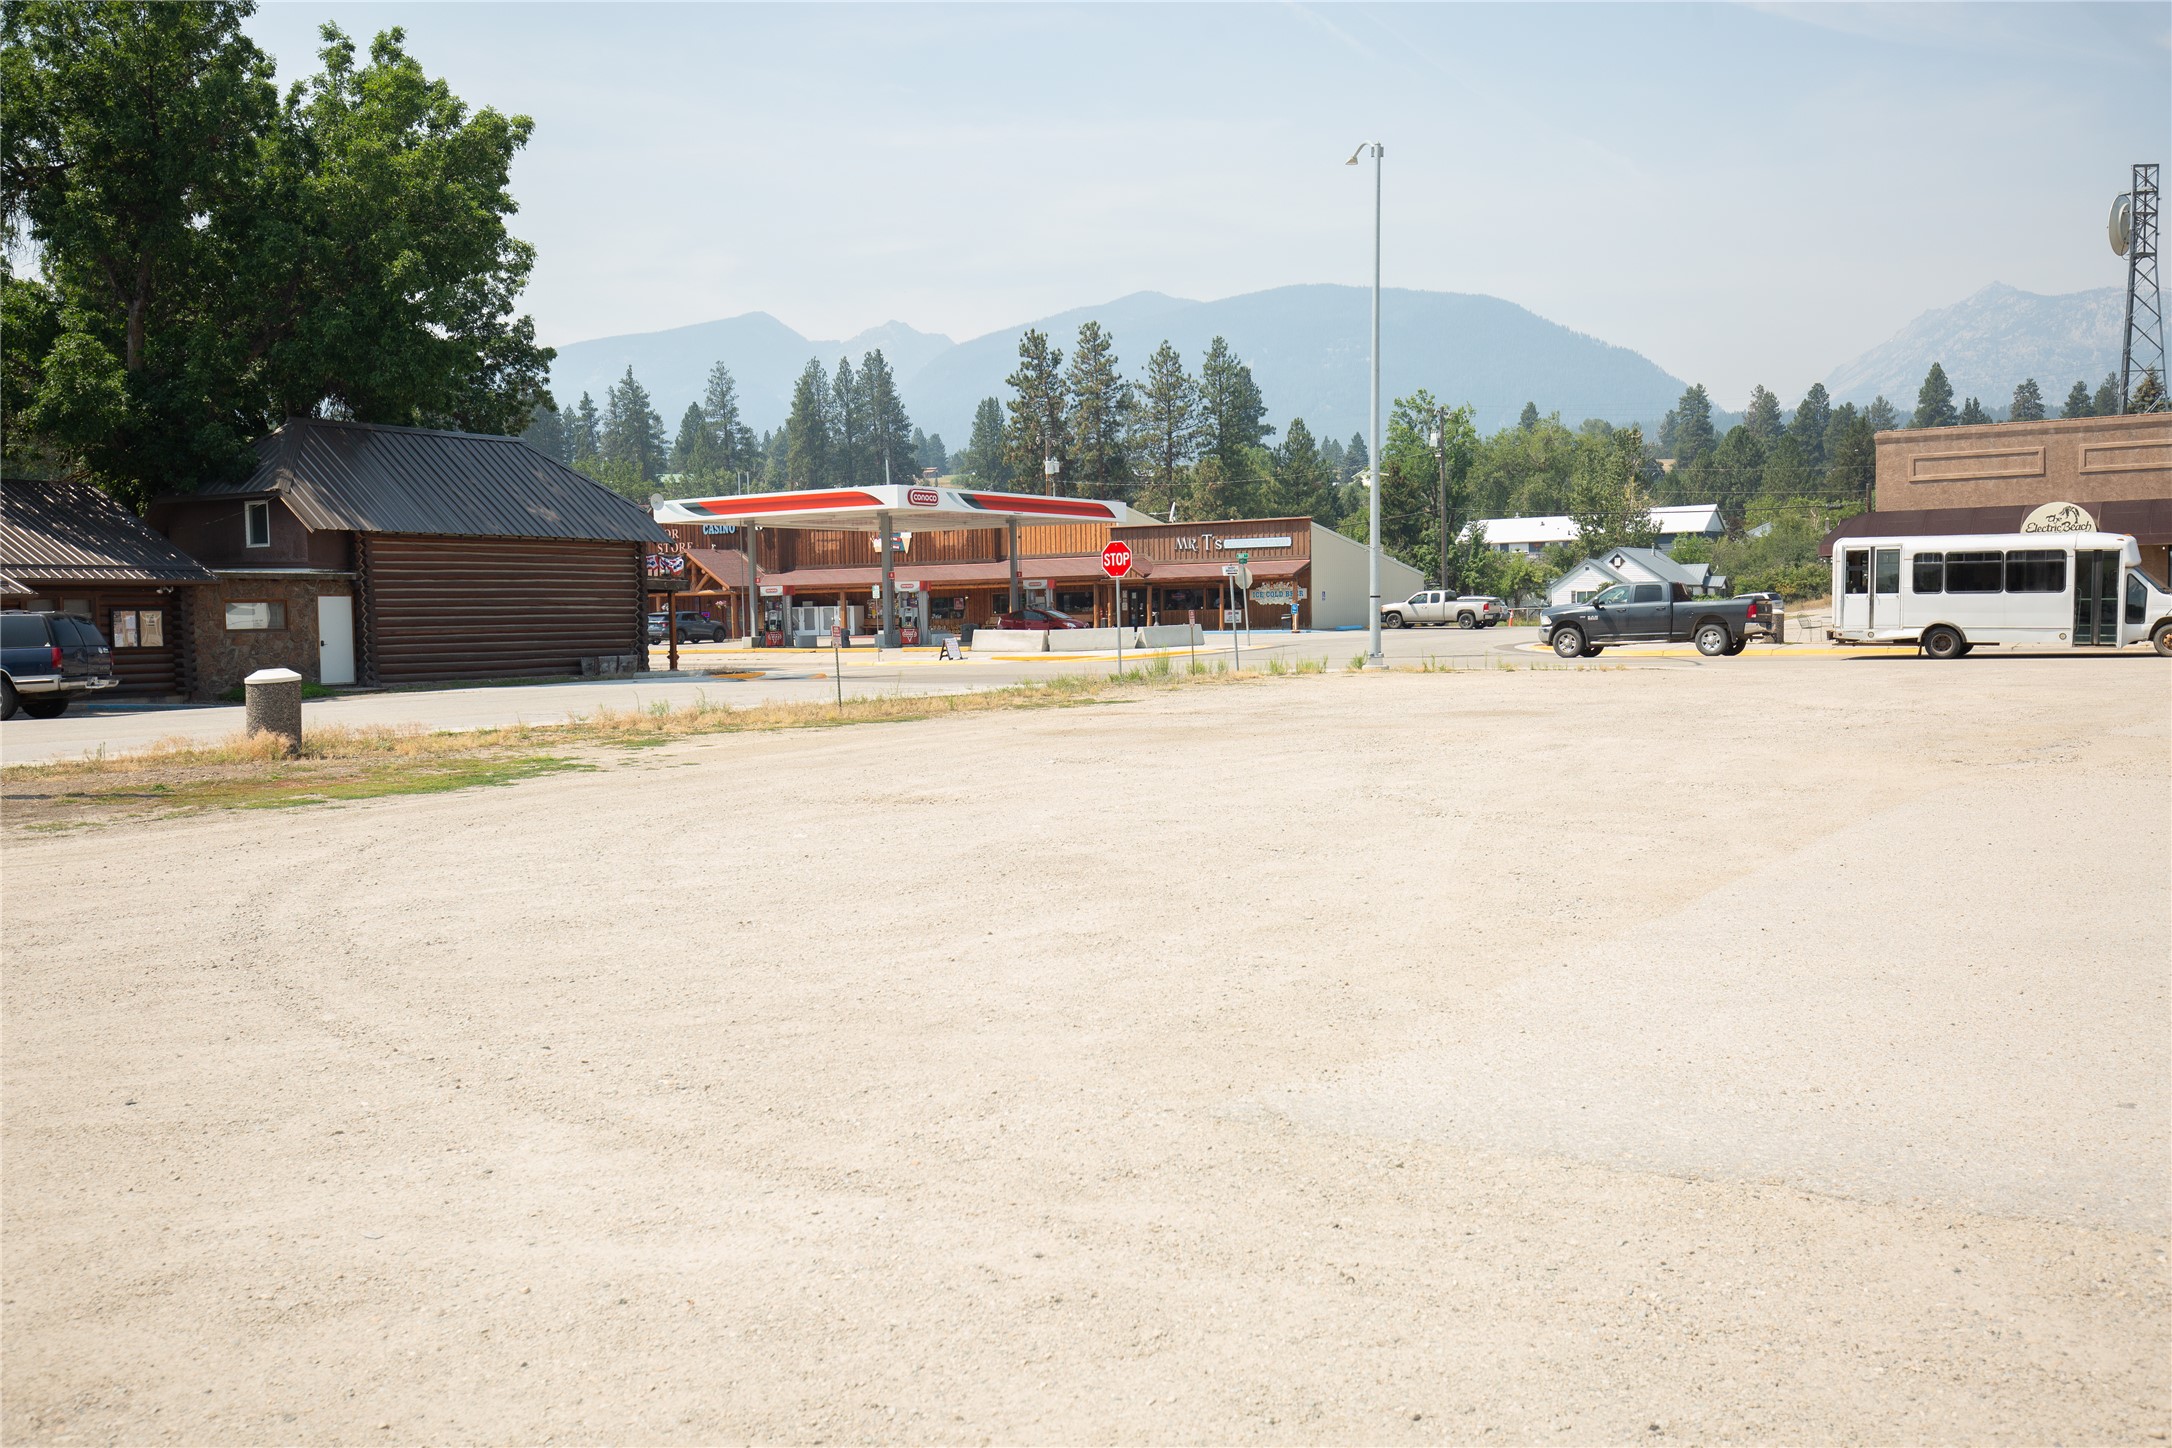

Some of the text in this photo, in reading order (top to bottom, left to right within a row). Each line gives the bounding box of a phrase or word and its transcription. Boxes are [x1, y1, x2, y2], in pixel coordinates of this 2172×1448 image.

[2046, 514, 2062, 523] The
[702, 523, 736, 535] CASINO
[2025, 521, 2092, 533] Electric Beach
[657, 541, 693, 554] STORE
[1201, 534, 1223, 550] T's
[1104, 552, 1130, 566] STOP
[1266, 590, 1284, 598] COLD
